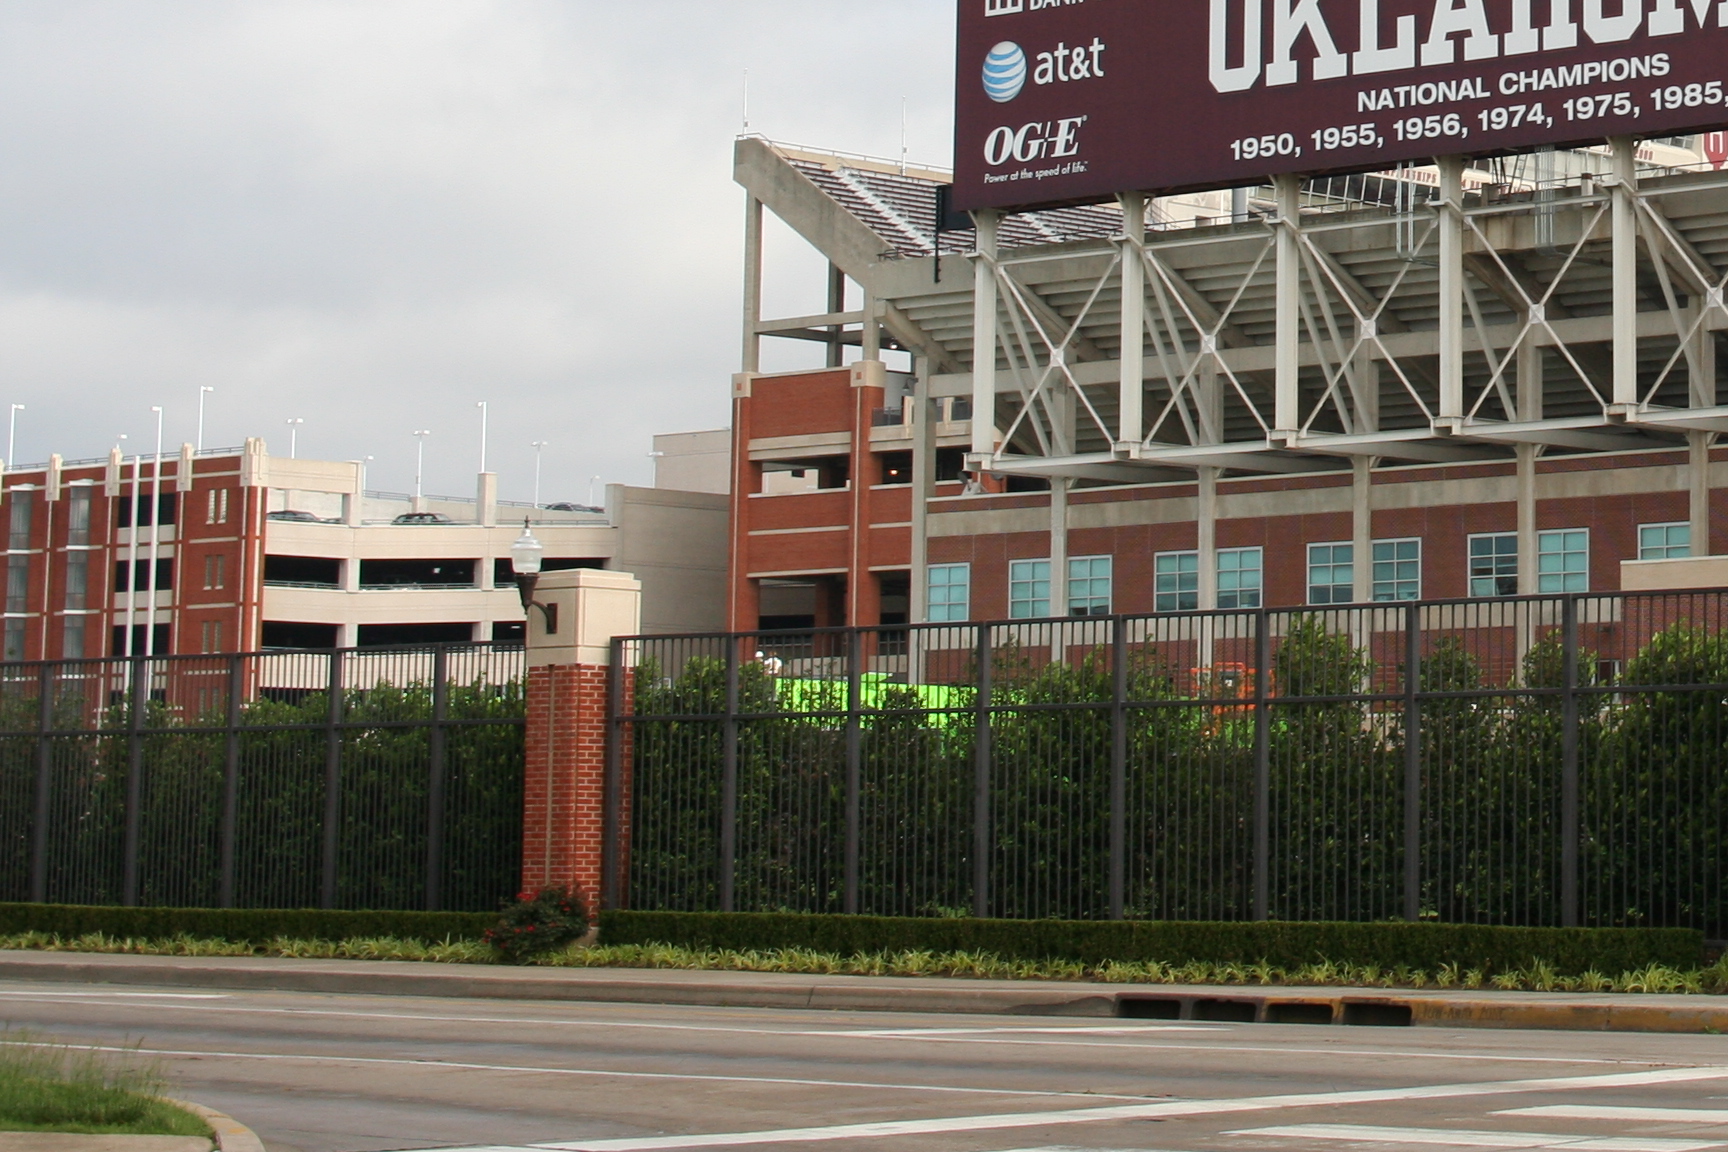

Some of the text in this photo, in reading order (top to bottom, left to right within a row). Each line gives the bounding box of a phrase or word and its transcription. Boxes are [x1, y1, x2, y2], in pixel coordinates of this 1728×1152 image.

[1033, 37, 1105, 85] at&t
[1357, 52, 1670, 113] NATIONAL CHAMPIONS
[1230, 132, 1301, 161] 1950,
[1310, 122, 1384, 151] 1955,
[1393, 113, 1468, 141] 1956,
[1478, 104, 1553, 132] 1974,
[1563, 91, 1640, 121] 1975,
